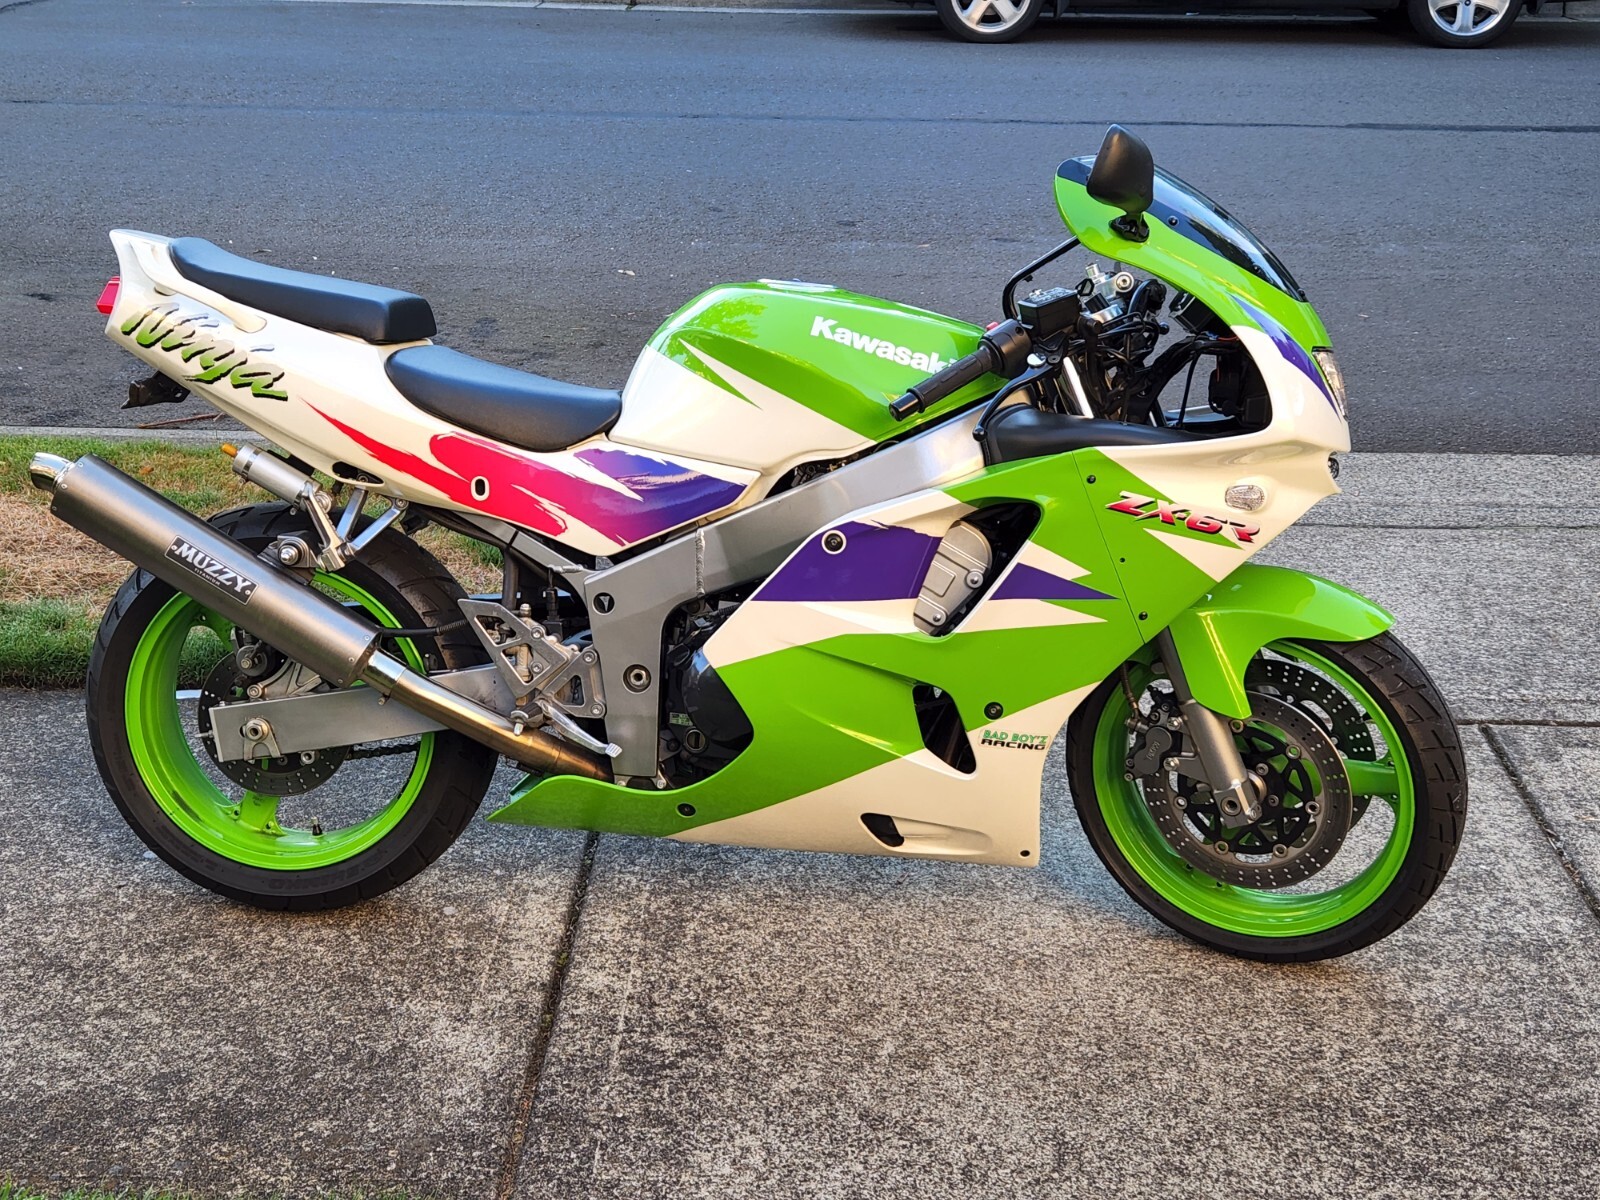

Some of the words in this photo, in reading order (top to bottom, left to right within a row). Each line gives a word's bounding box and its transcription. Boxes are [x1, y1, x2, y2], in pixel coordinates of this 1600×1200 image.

[121, 303, 288, 401] Ninja
[810, 316, 959, 375] Kawasak
[1105, 490, 1260, 543] ZX-6R
[174, 543, 251, 593] MUZZY
[194, 568, 221, 586] TITANIUM
[981, 738, 1046, 750] RACING
[983, 730, 1009, 741] BAD
[1011, 733, 1048, 744] BOY'Z
